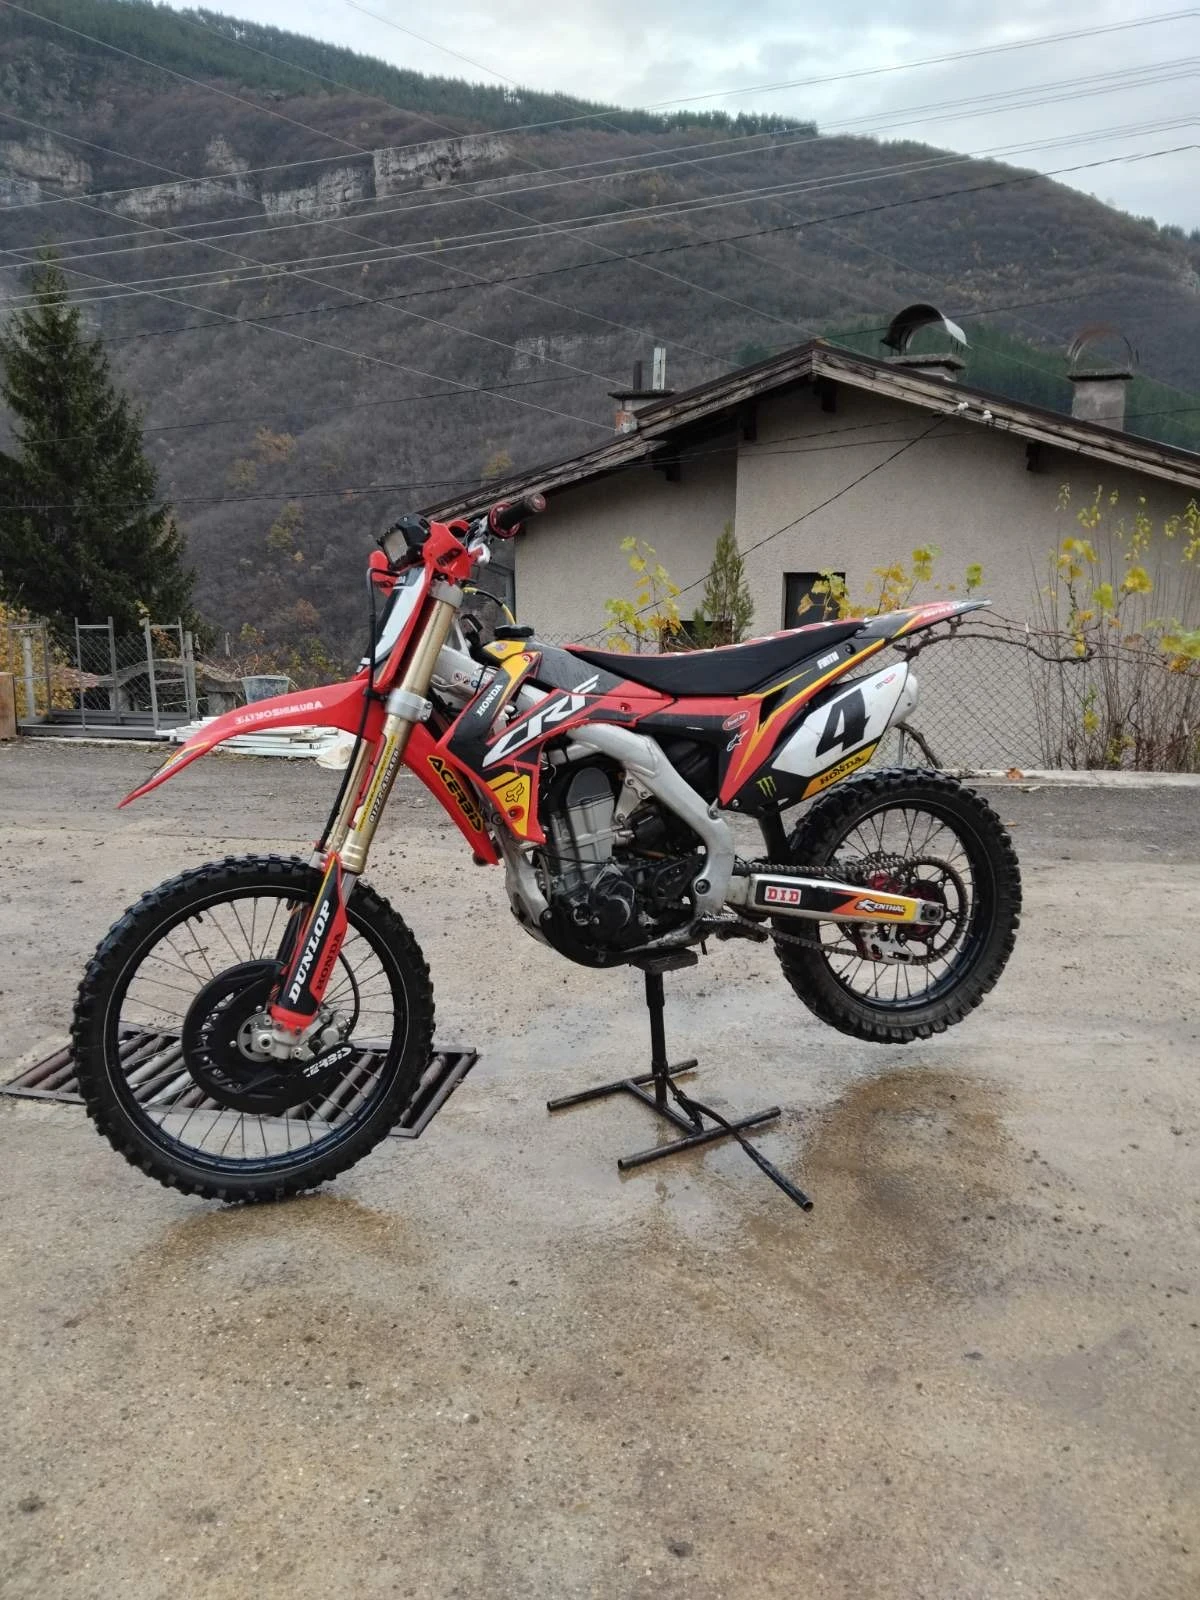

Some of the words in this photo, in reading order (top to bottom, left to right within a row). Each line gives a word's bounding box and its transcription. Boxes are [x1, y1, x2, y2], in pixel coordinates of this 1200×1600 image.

[476, 684, 503, 717] HONDA
[815, 688, 871, 758] 4
[820, 754, 866, 785] HONDA
[288, 899, 330, 1004] DUNLOP
[316, 932, 343, 991] HONDA
